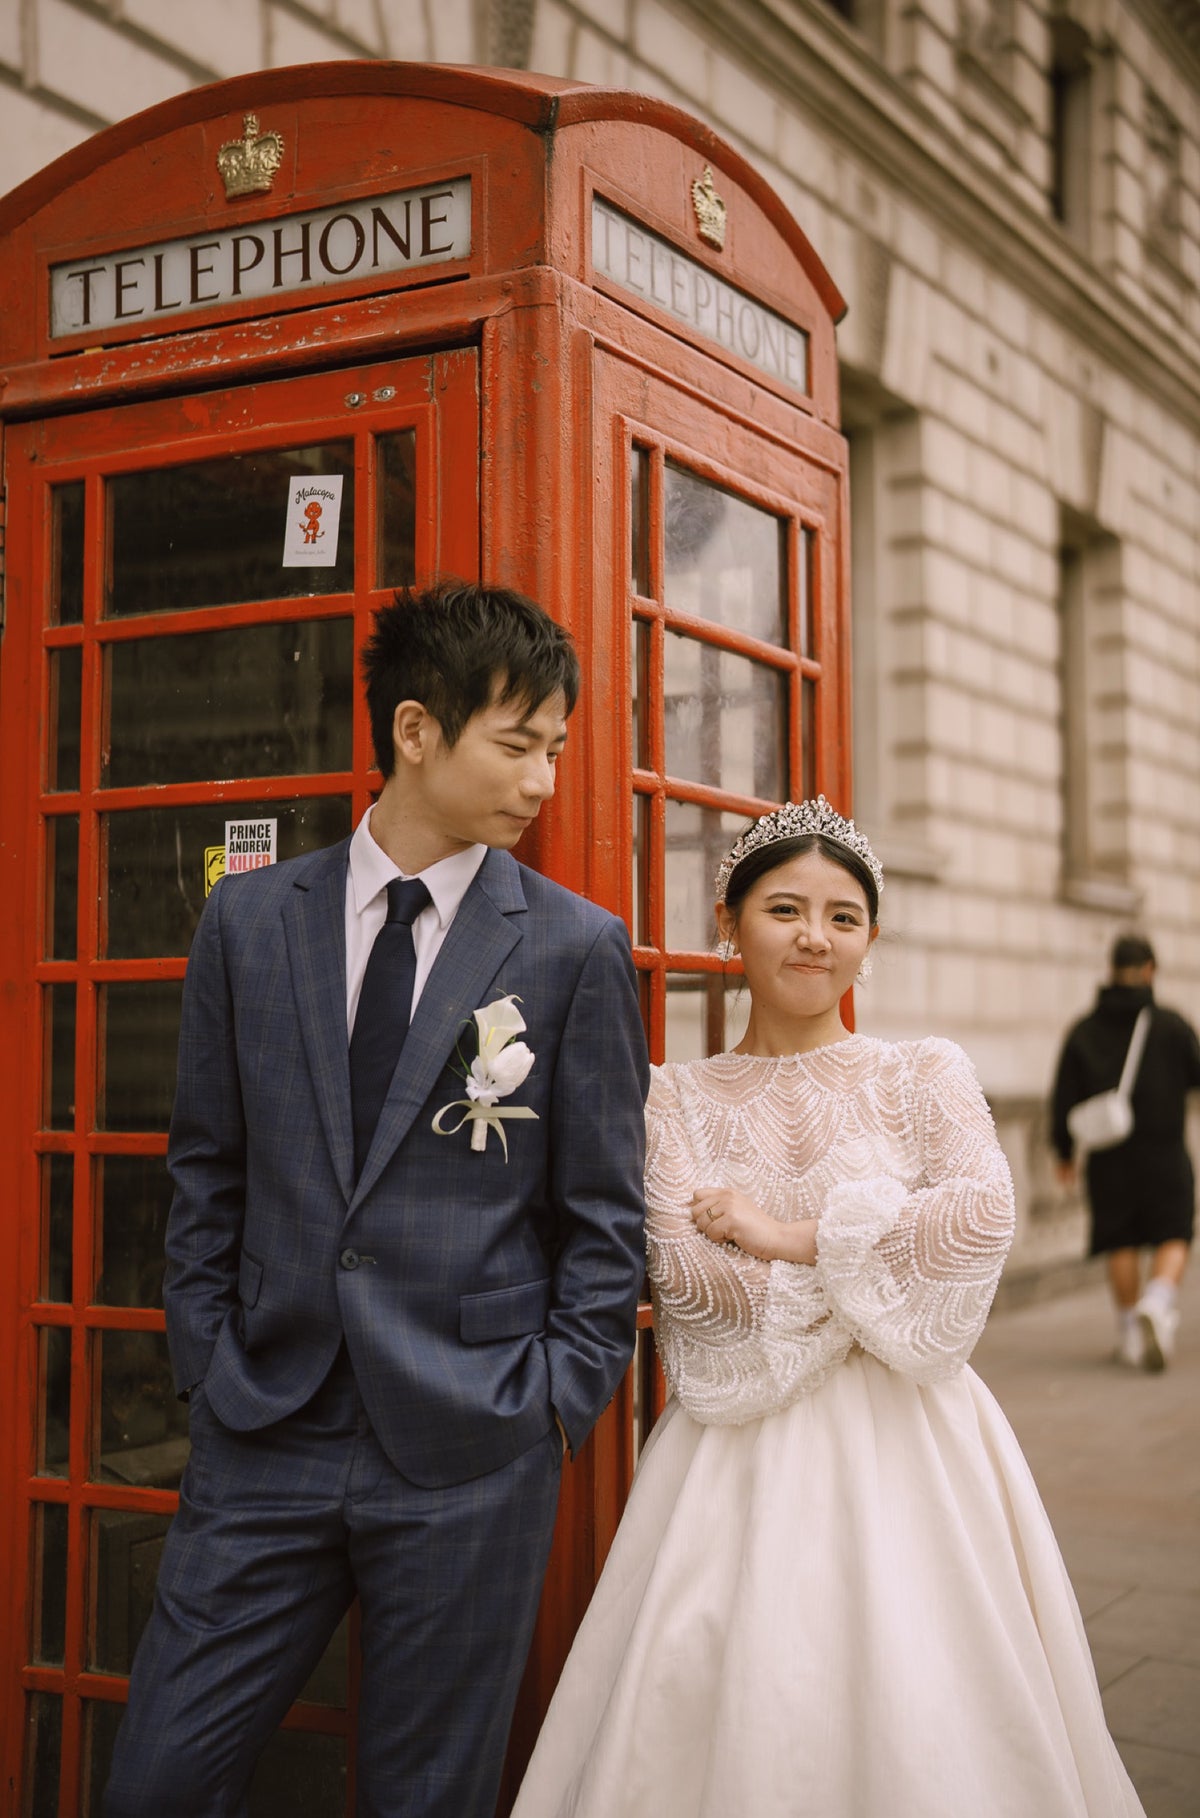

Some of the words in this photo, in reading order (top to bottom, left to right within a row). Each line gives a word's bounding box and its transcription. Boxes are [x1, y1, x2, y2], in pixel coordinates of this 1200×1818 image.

[67, 191, 455, 326] TELEPHONE
[594, 205, 800, 386] TELEPHONE
[295, 486, 335, 504] Malacopa
[230, 824, 271, 839] PRINCE
[229, 840, 271, 853] ANDREW
